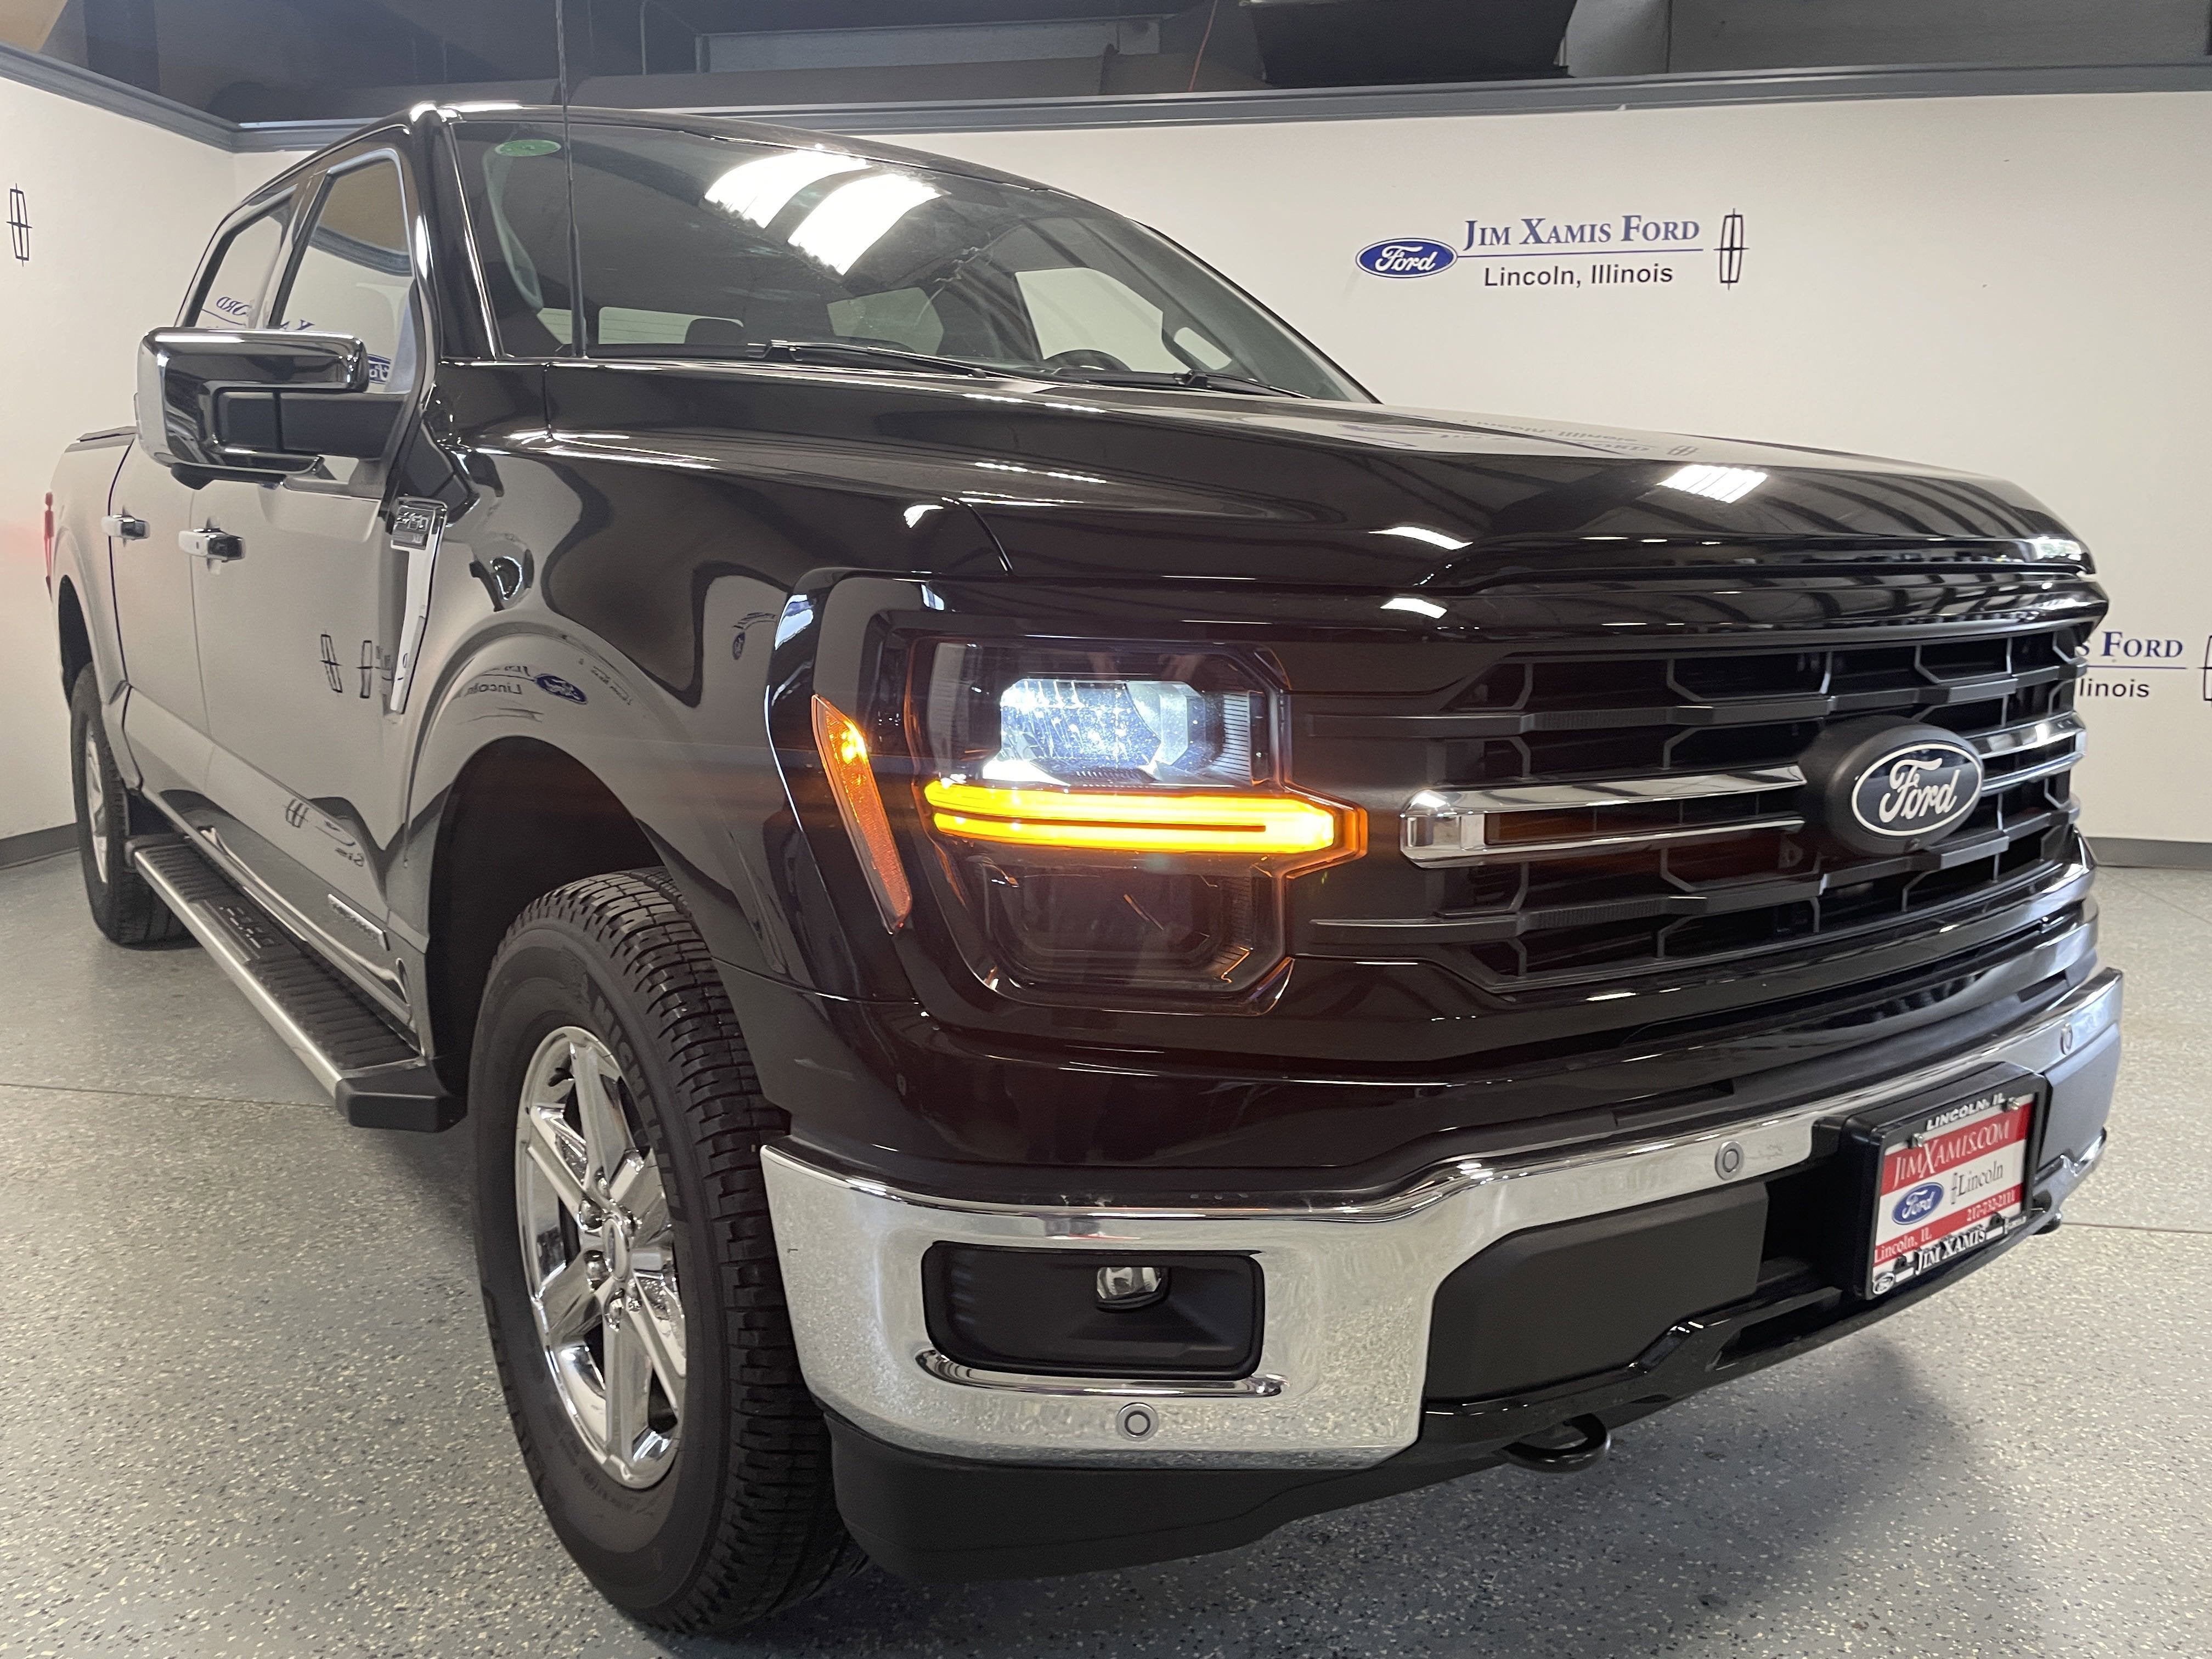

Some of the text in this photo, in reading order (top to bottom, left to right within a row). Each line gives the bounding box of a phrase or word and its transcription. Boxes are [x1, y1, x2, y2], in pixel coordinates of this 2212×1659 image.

[1463, 215, 1700, 251] JIM XAMIS FORD
[1375, 245, 1438, 272] Ford
[1484, 263, 1674, 289] Lincoln, Illinois
[2100, 631, 2183, 658] FORD
[2079, 678, 2151, 698] linois
[1878, 757, 1962, 823] Ford
[1957, 1160, 2004, 1197] Lincoln
[1901, 1189, 1936, 1219] Ford
[1914, 1229, 1987, 1276] JIM XAMIS
